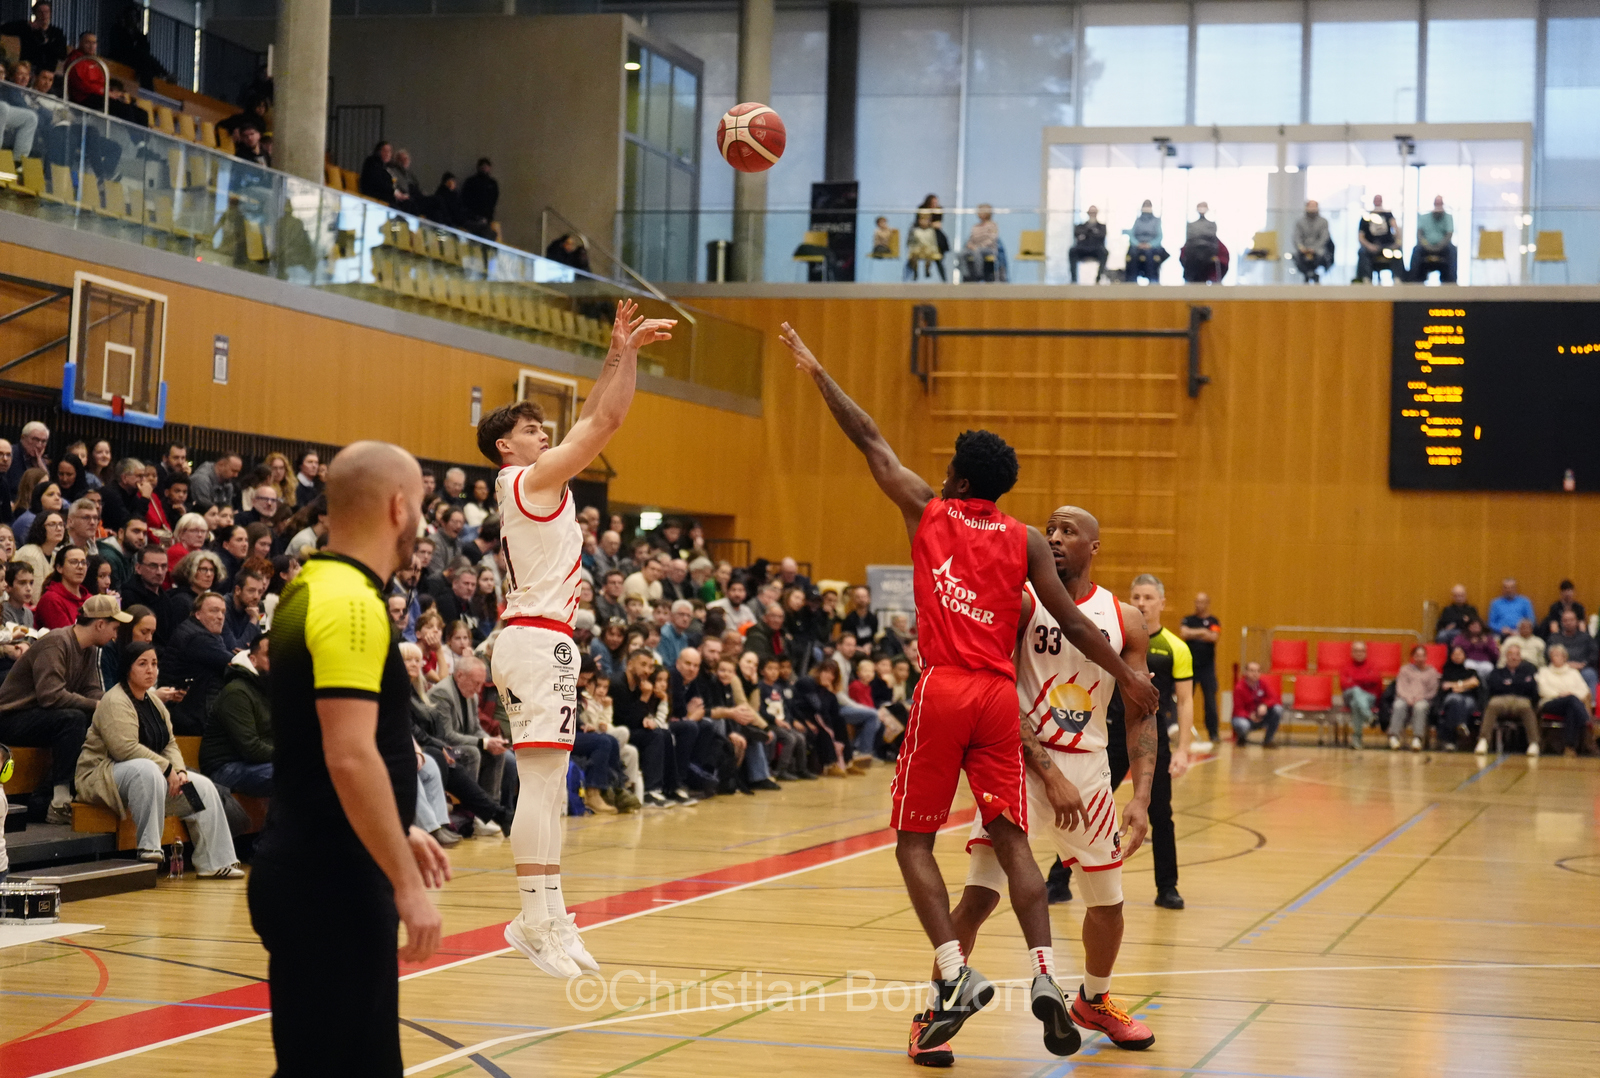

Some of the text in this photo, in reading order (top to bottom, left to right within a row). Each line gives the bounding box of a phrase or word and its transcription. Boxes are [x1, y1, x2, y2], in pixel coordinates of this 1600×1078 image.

[944, 580, 977, 603] TOP
[939, 592, 995, 625] CORER
[1034, 624, 1062, 656] 33
